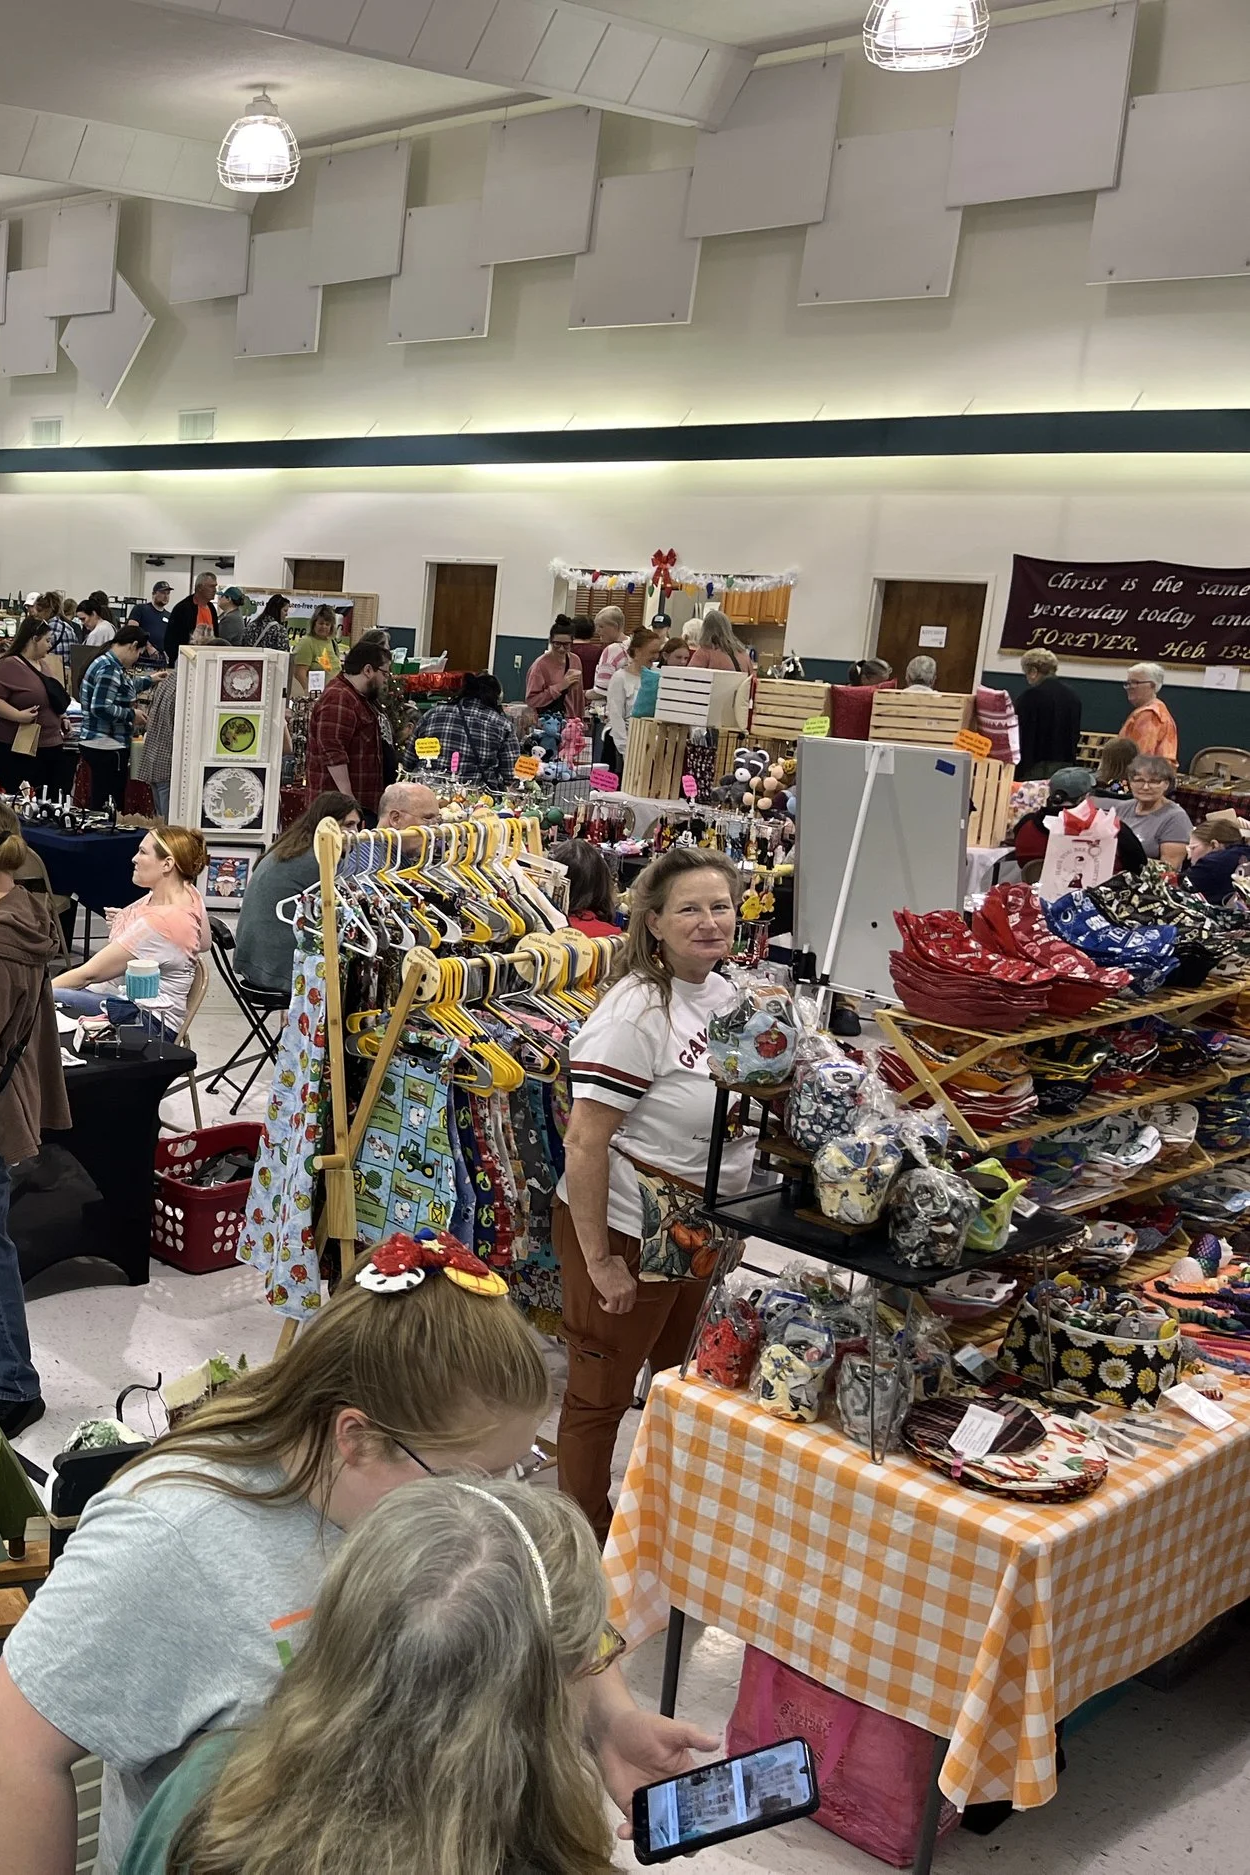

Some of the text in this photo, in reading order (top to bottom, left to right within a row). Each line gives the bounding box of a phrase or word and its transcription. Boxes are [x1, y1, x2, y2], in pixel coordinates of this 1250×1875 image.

[1048, 571, 1250, 597] Christ is the same
[1028, 602, 1129, 625] yesterday
[1138, 606, 1196, 630] today
[1158, 641, 1206, 658] Heb.
[1216, 671, 1226, 686] 2
